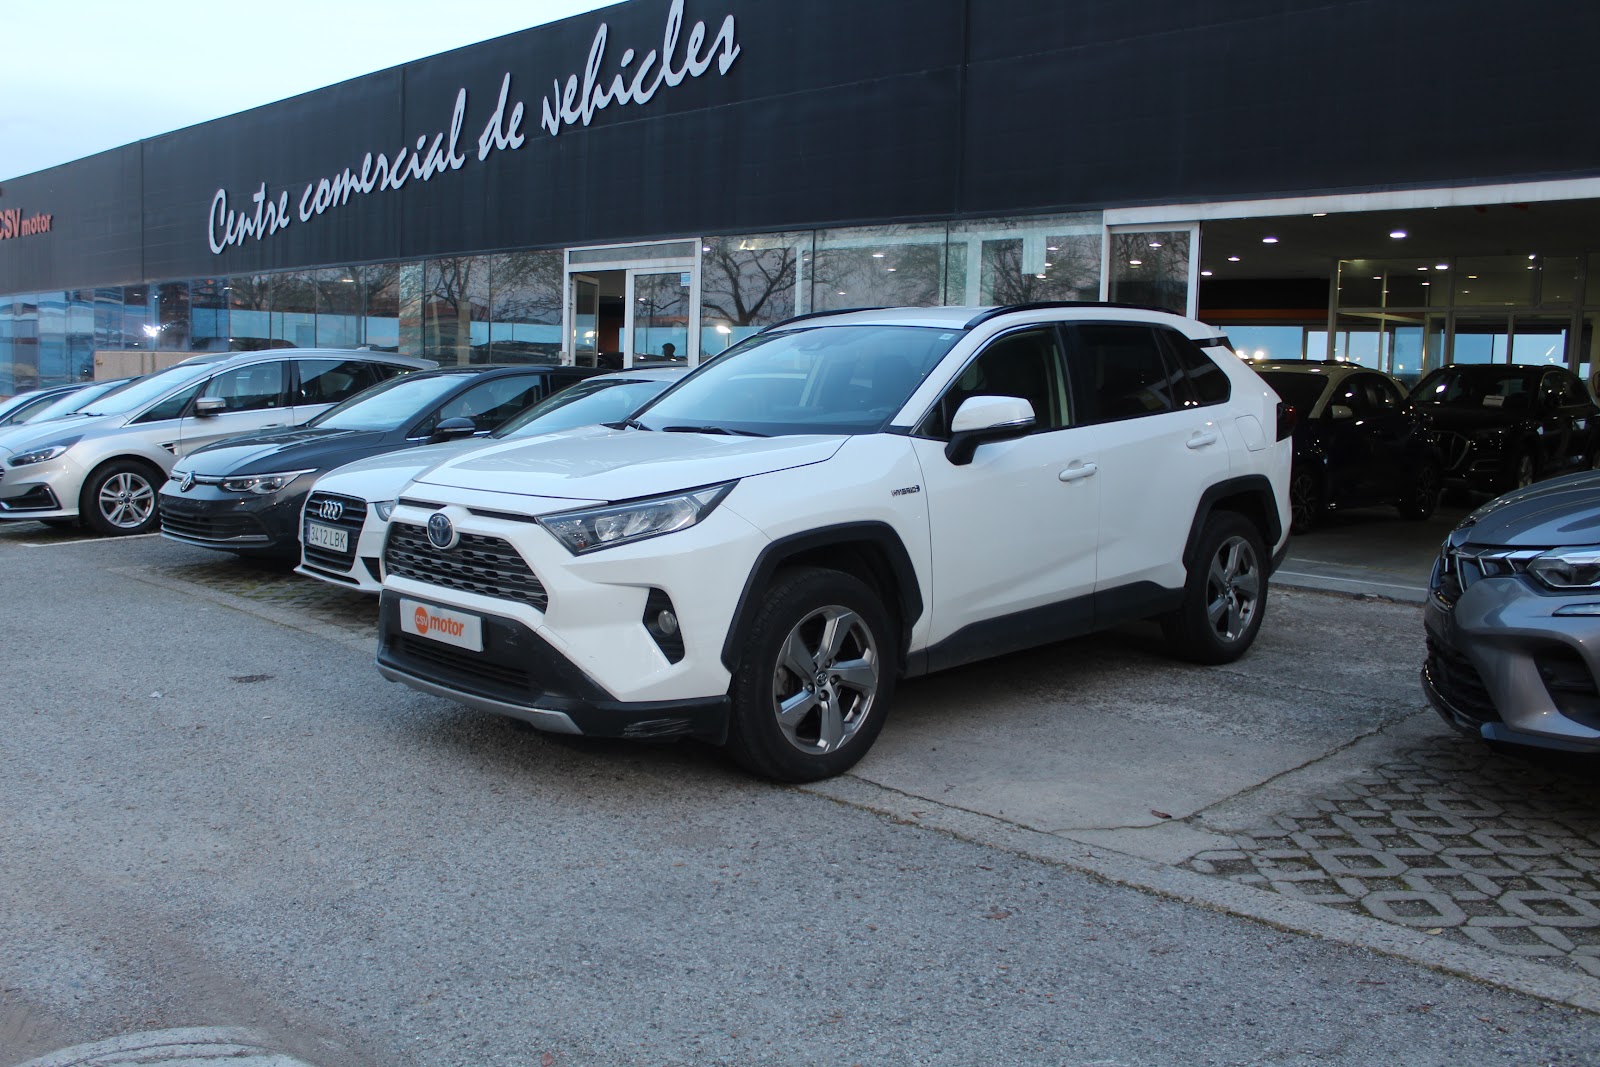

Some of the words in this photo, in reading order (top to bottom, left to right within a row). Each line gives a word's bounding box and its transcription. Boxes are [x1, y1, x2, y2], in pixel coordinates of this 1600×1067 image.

[209, 182, 290, 254] Centre
[299, 88, 466, 222] comercial
[478, 72, 524, 161] de
[541, 0, 741, 136] vehicles
[21, 212, 51, 236] motor
[890, 485, 920, 497] HYBRID
[311, 526, 328, 545] 3412
[329, 530, 346, 549] LBK
[429, 615, 465, 637] motor
